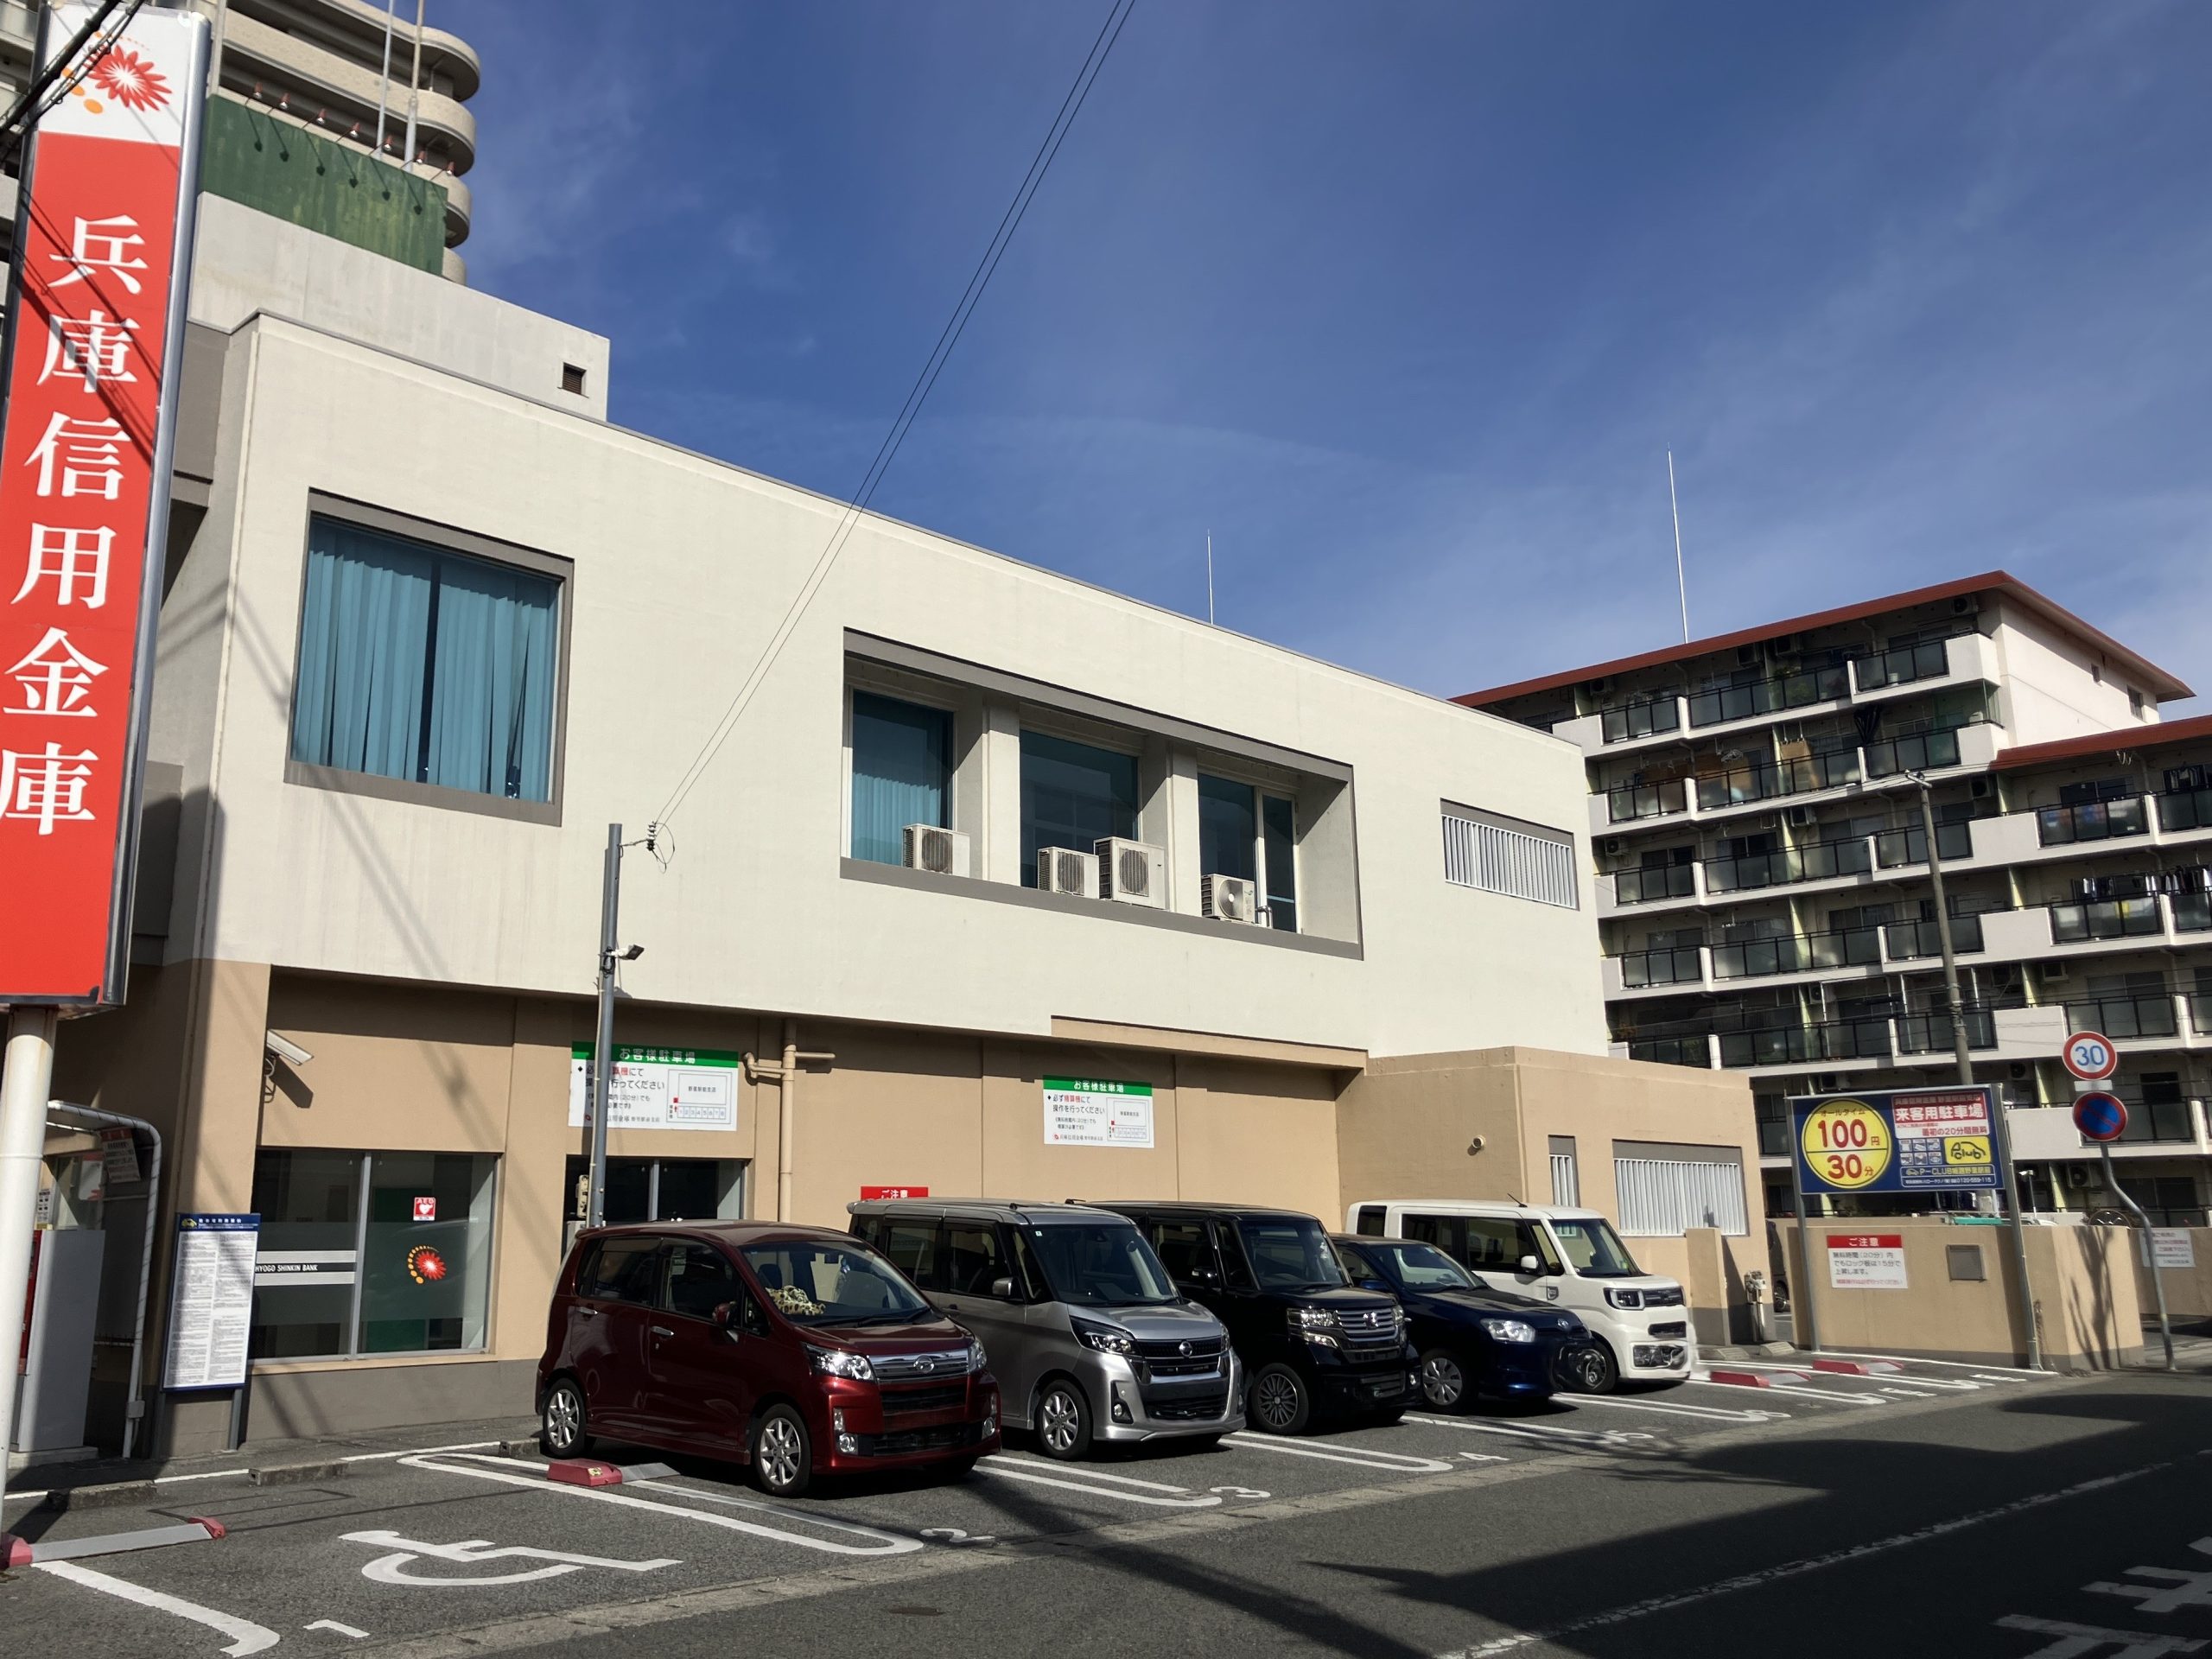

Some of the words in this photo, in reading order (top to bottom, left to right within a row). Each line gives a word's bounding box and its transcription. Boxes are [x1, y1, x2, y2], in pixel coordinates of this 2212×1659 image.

[0, 214, 149, 836] 兵庫信用金庫
[620, 1048, 696, 1064] お客様駐車場
[2075, 1046, 2105, 1066] 30
[1073, 1082, 1124, 1092] お客様駐車場
[1052, 1104, 1105, 1114] 操作を行ってください
[1821, 1108, 1866, 1117] オールタイム
[1895, 1103, 1984, 1122] 来客用駐車場
[1922, 1126, 1986, 1136] 最初の20分間無料
[1848, 1237, 1879, 1247] ご注意
[1210, 1486, 1271, 1498] 3
[919, 1528, 995, 1544] 2
[303, 1619, 371, 1638] 1
